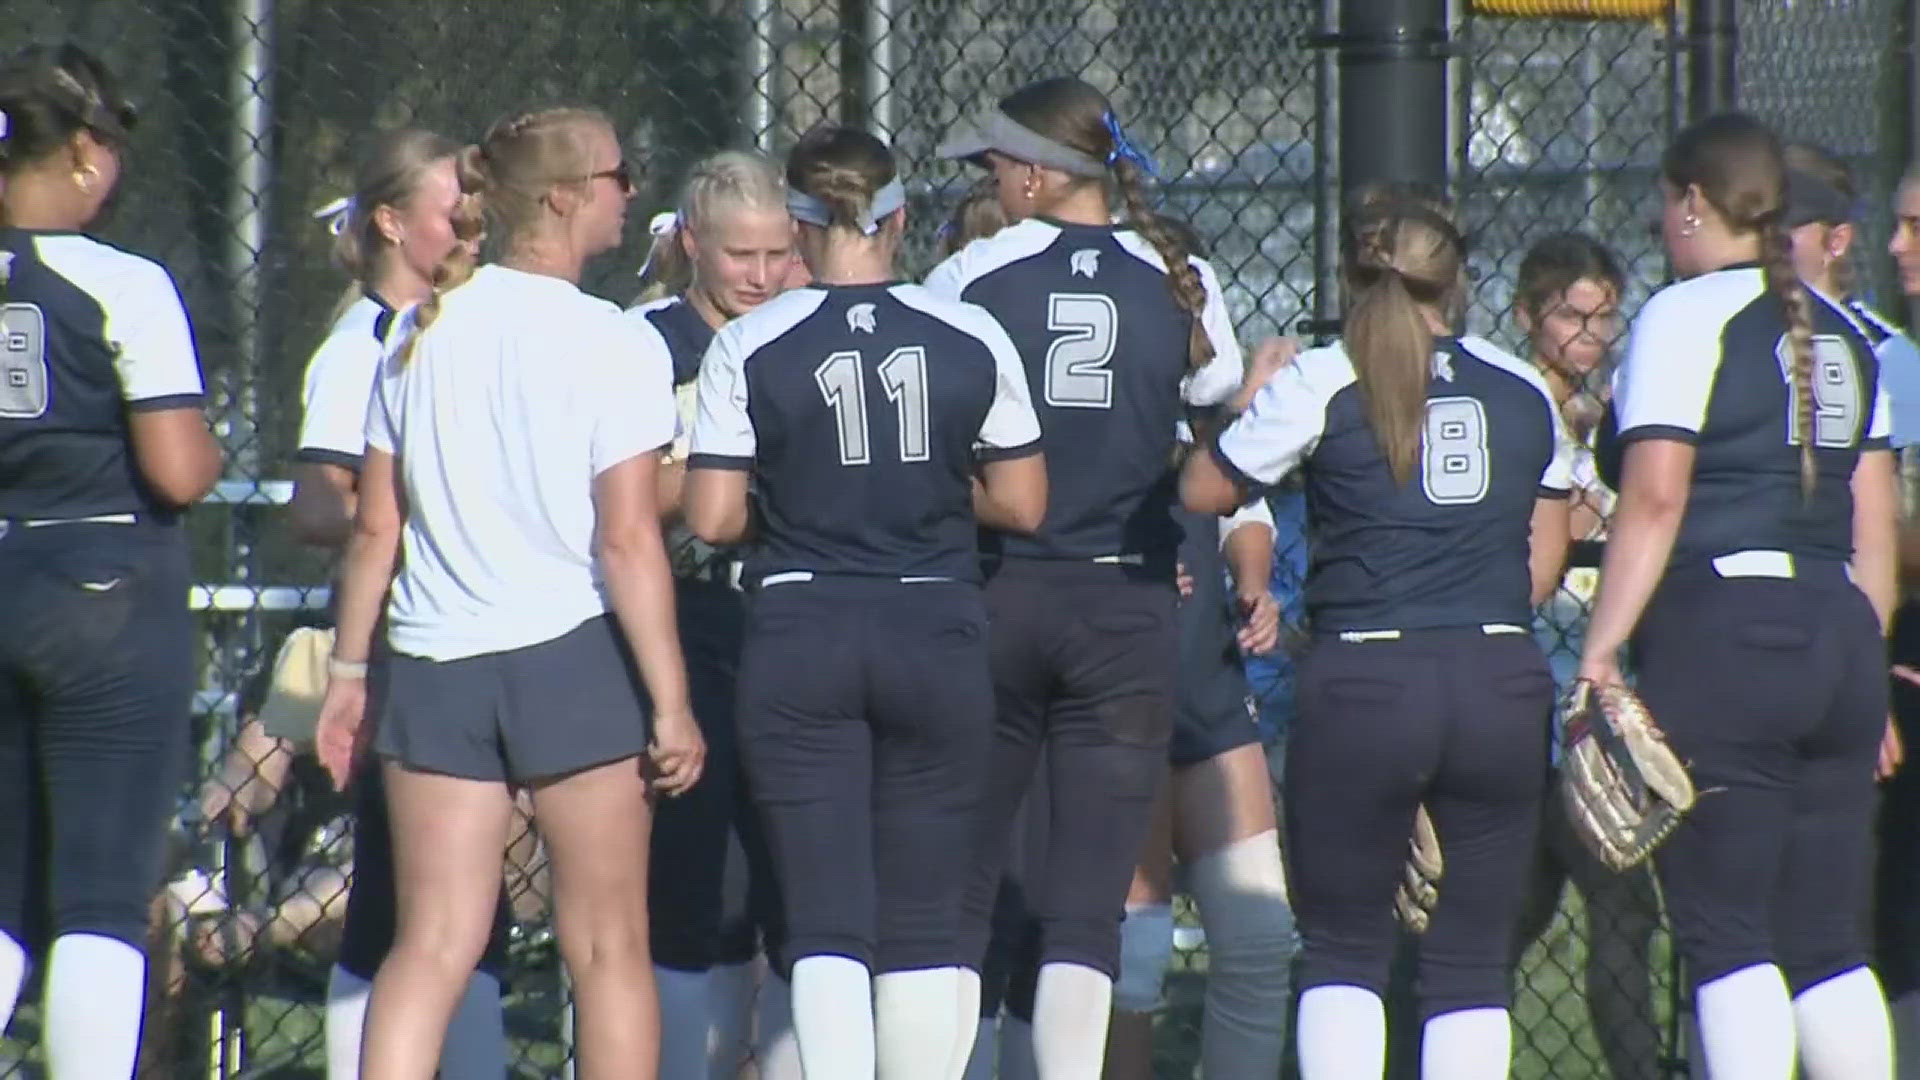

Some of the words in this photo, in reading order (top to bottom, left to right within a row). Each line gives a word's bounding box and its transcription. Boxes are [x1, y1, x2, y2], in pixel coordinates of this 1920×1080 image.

[814, 346, 930, 466] 11
[1045, 292, 1118, 409] 2
[1422, 396, 1490, 505] 8
